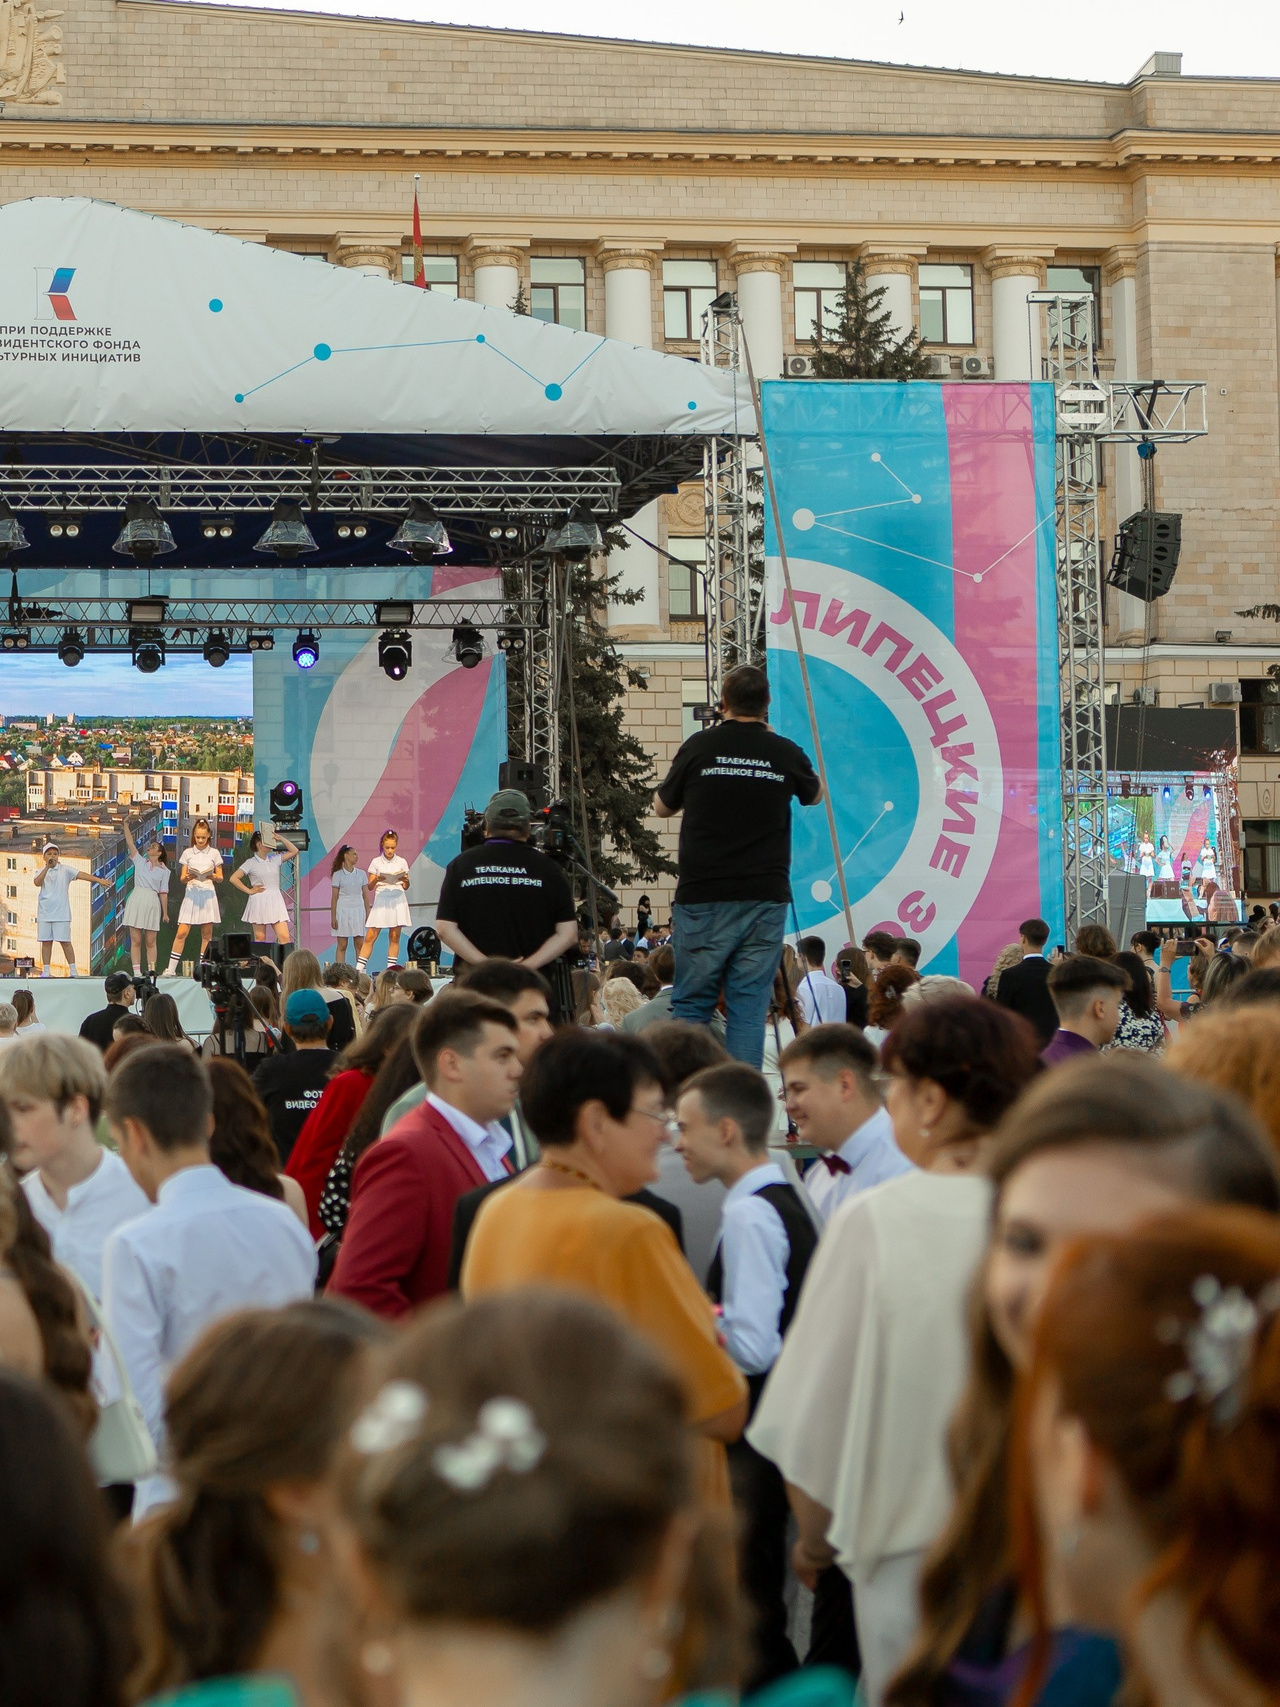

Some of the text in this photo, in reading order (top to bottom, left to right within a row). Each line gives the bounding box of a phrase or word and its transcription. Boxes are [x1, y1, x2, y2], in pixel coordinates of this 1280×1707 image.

[0, 325, 112, 337] ПРИ ПОДДЕРЖКЕ
[93, 340, 141, 350] ФОНДА
[62, 353, 141, 363] ИНИЦИАТИВ
[769, 588, 980, 880] ЛИПЕЦКИЕ
[715, 756, 771, 768] ТЕЛЕКАНАЛ
[700, 767, 785, 783] ЛИПЕЦКОЕ ВРЕМЯ
[475, 866, 527, 874] ТЕЛЕКАНАЛ
[461, 877, 542, 887] ЛИПЕЦКОЕ ВРЕМЯ
[303, 1089, 324, 1099] ФОТ
[285, 1100, 319, 1110] ВИДЕО
